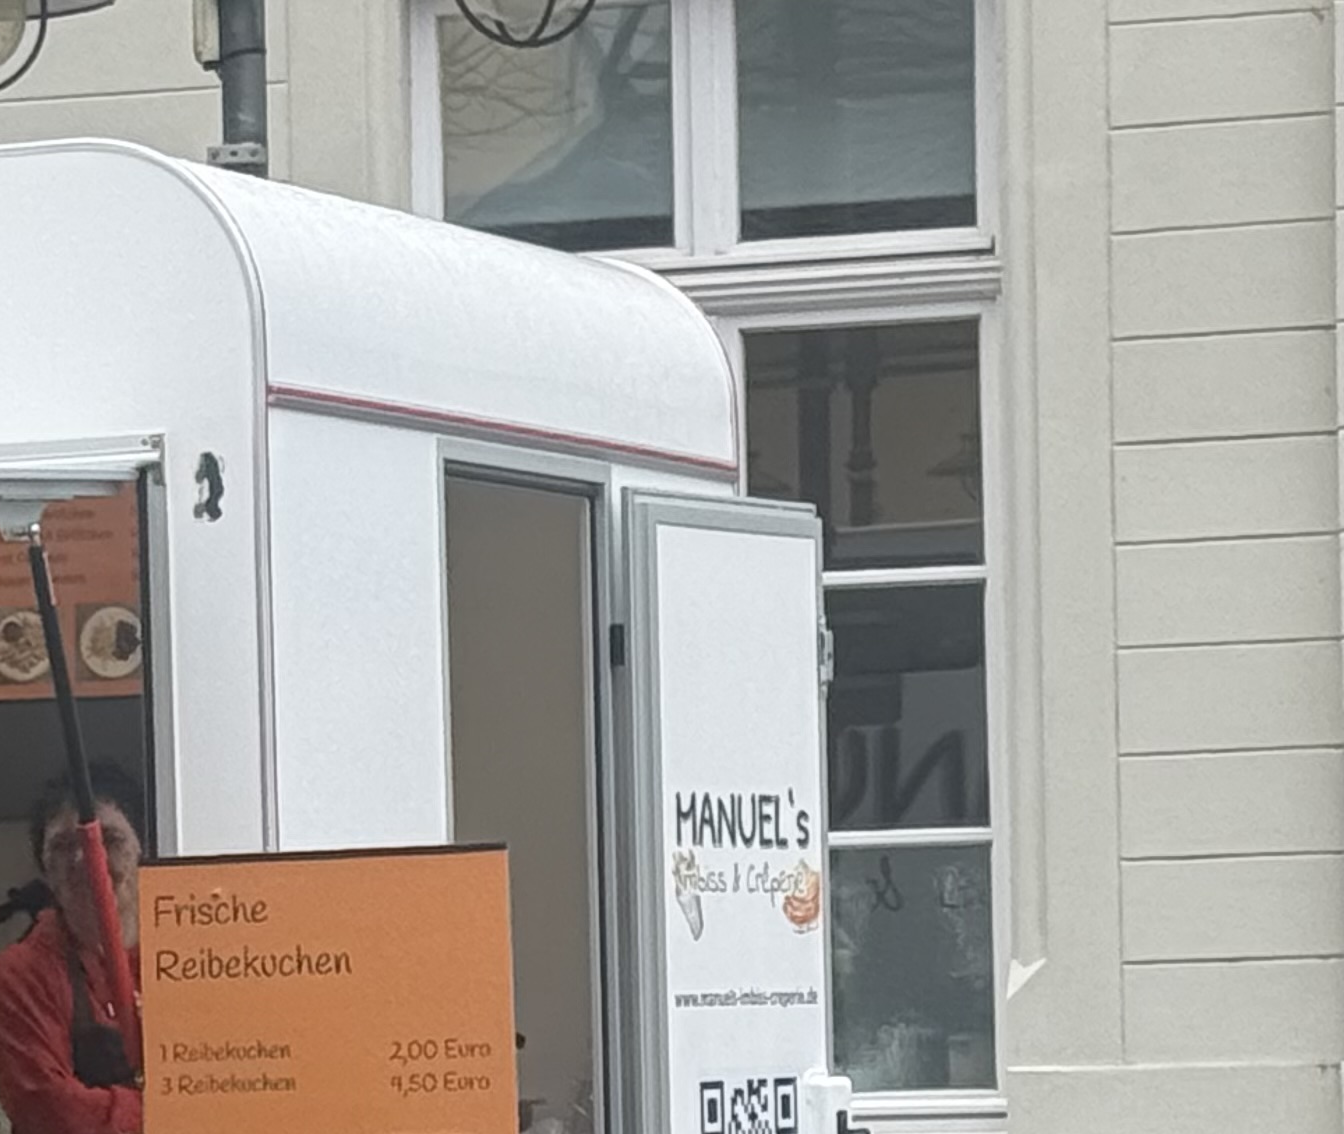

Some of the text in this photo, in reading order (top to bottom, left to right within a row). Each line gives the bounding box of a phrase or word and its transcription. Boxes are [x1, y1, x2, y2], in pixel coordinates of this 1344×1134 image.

[675, 787, 810, 849] MANUEL's
[153, 893, 268, 929] Frische
[156, 944, 352, 982] Reibekuchen
[160, 1037, 492, 1067] 1 Reibekuchen 2,00 Euro
[162, 1070, 491, 1098] 3 Reibekuchen 4,50 Euro
